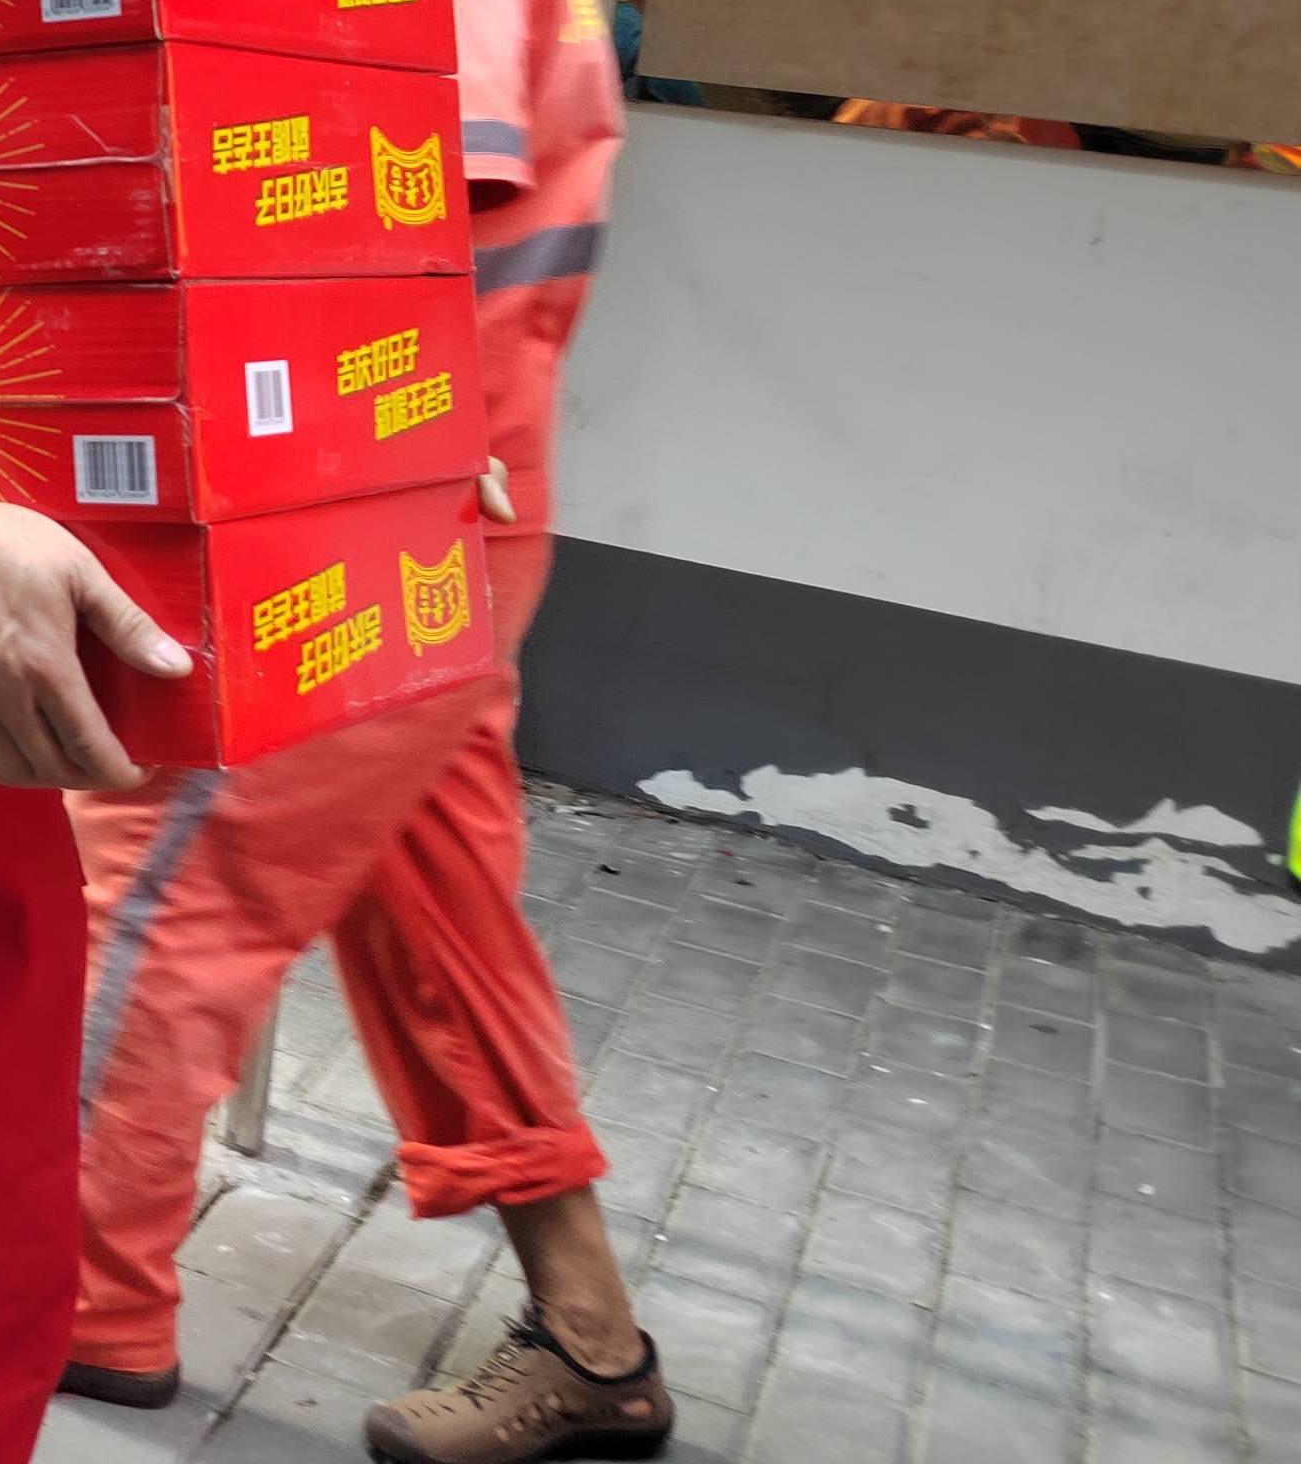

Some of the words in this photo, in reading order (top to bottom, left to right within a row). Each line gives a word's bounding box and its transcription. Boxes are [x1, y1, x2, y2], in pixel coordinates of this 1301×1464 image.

[337, 328, 420, 396] 吉庆好日子
